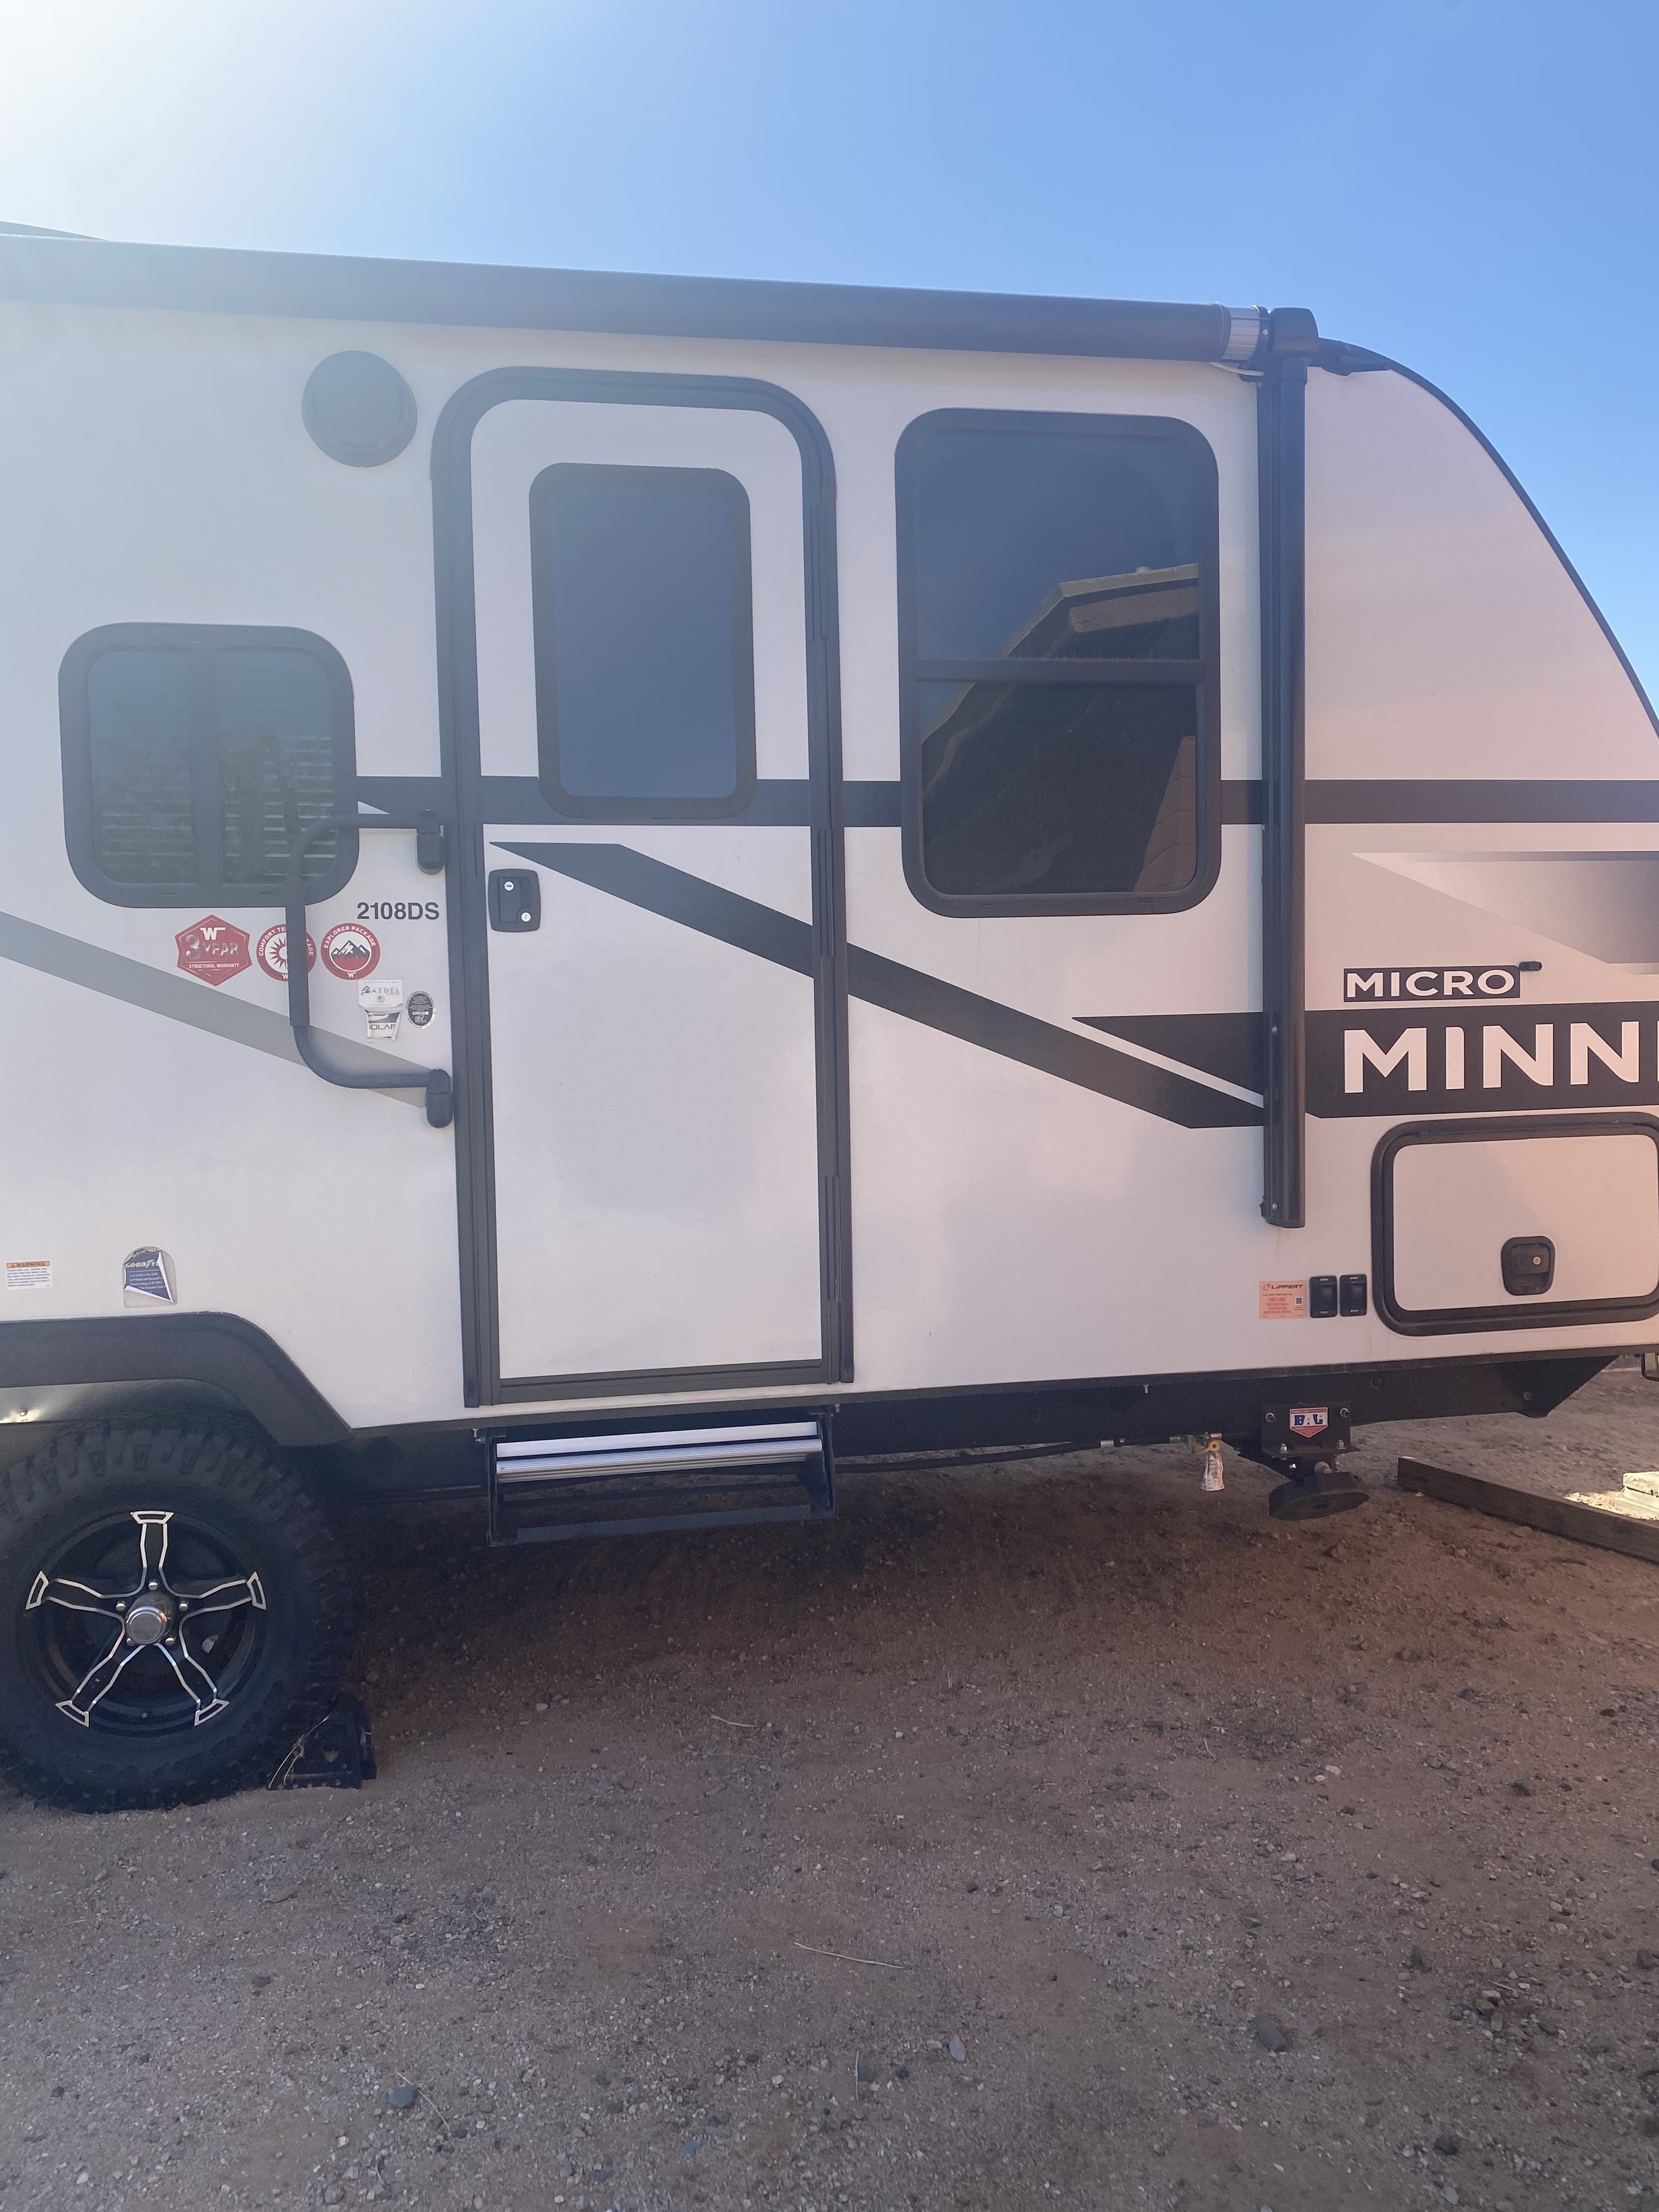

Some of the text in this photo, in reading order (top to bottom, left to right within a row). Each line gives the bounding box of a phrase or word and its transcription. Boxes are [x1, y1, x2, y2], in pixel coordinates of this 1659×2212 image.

[357, 901, 440, 920] 2108DS
[185, 934, 239, 960] 3 YEAR
[258, 929, 275, 956] COMFORT
[323, 926, 376, 949] EXPLORER PACKAGE
[1346, 969, 1515, 998] MICRO
[1344, 1020, 1659, 1094] MINN
